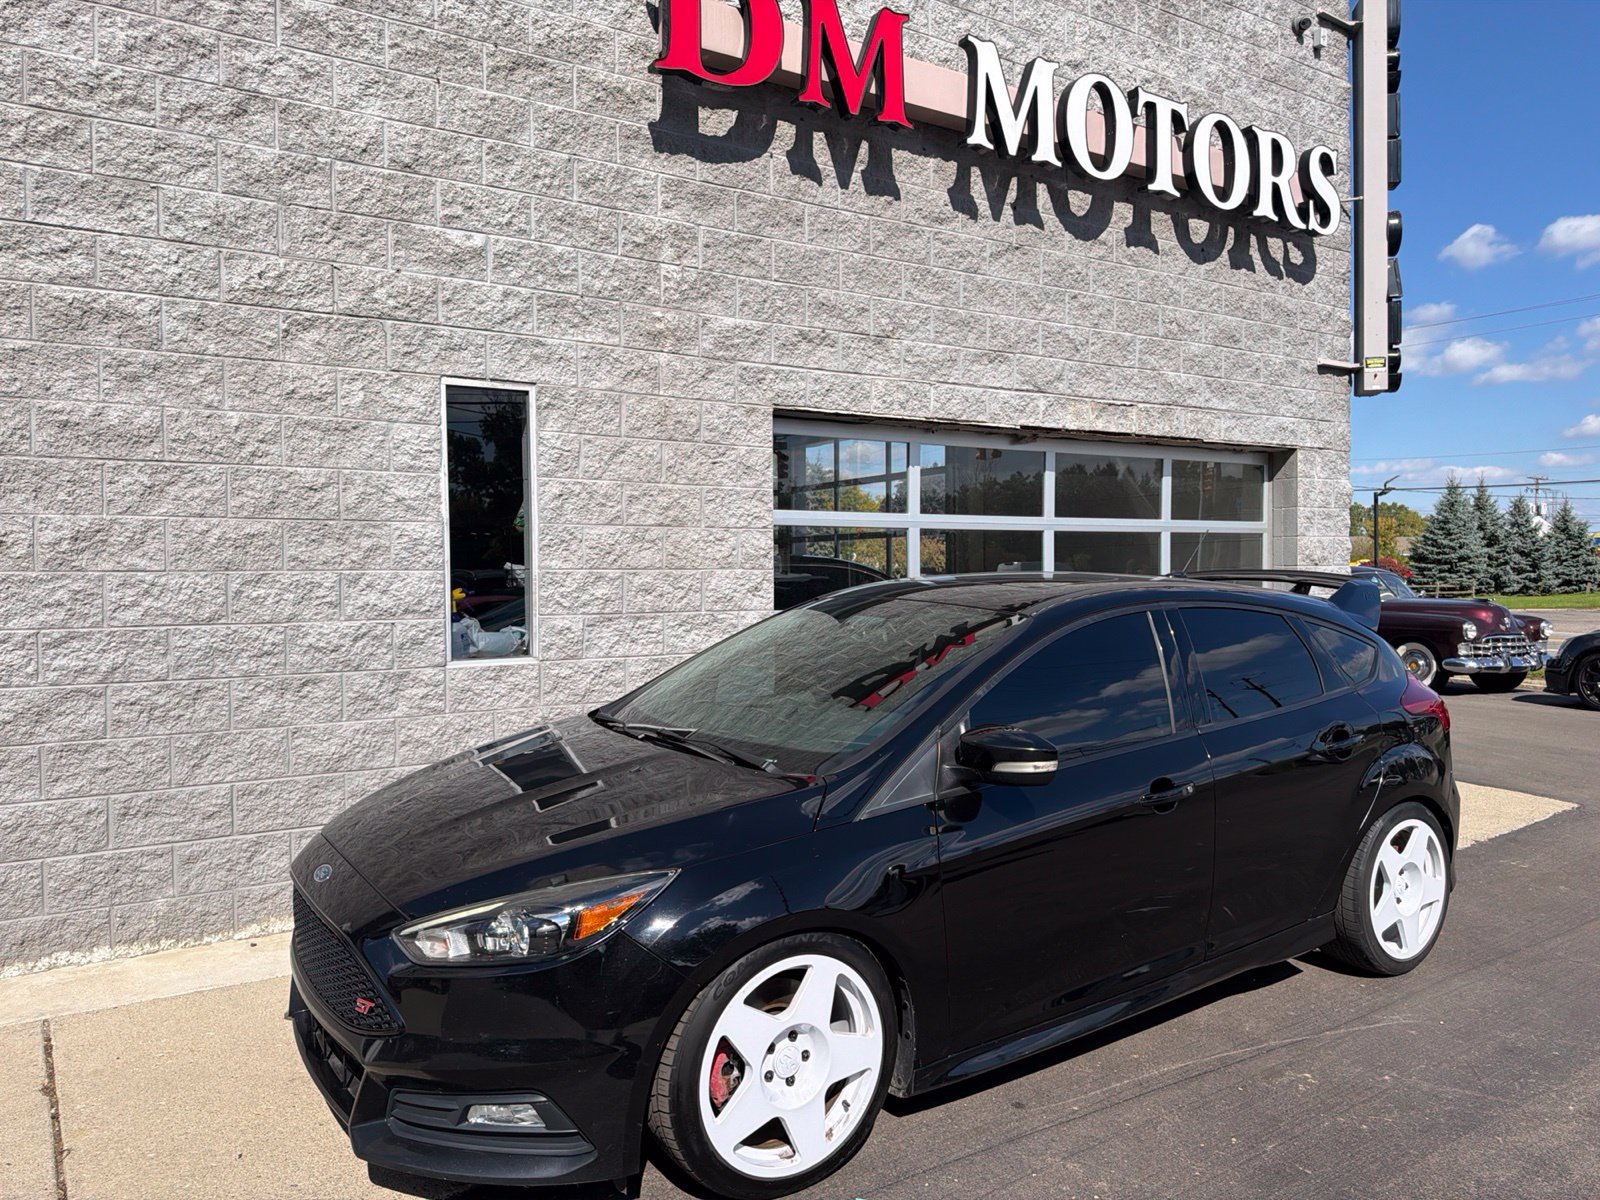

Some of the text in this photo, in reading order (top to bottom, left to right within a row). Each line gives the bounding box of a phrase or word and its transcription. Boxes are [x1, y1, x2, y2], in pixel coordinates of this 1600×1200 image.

[654, 0, 1341, 236] DM MOTORS
[355, 997, 375, 1015] ST
